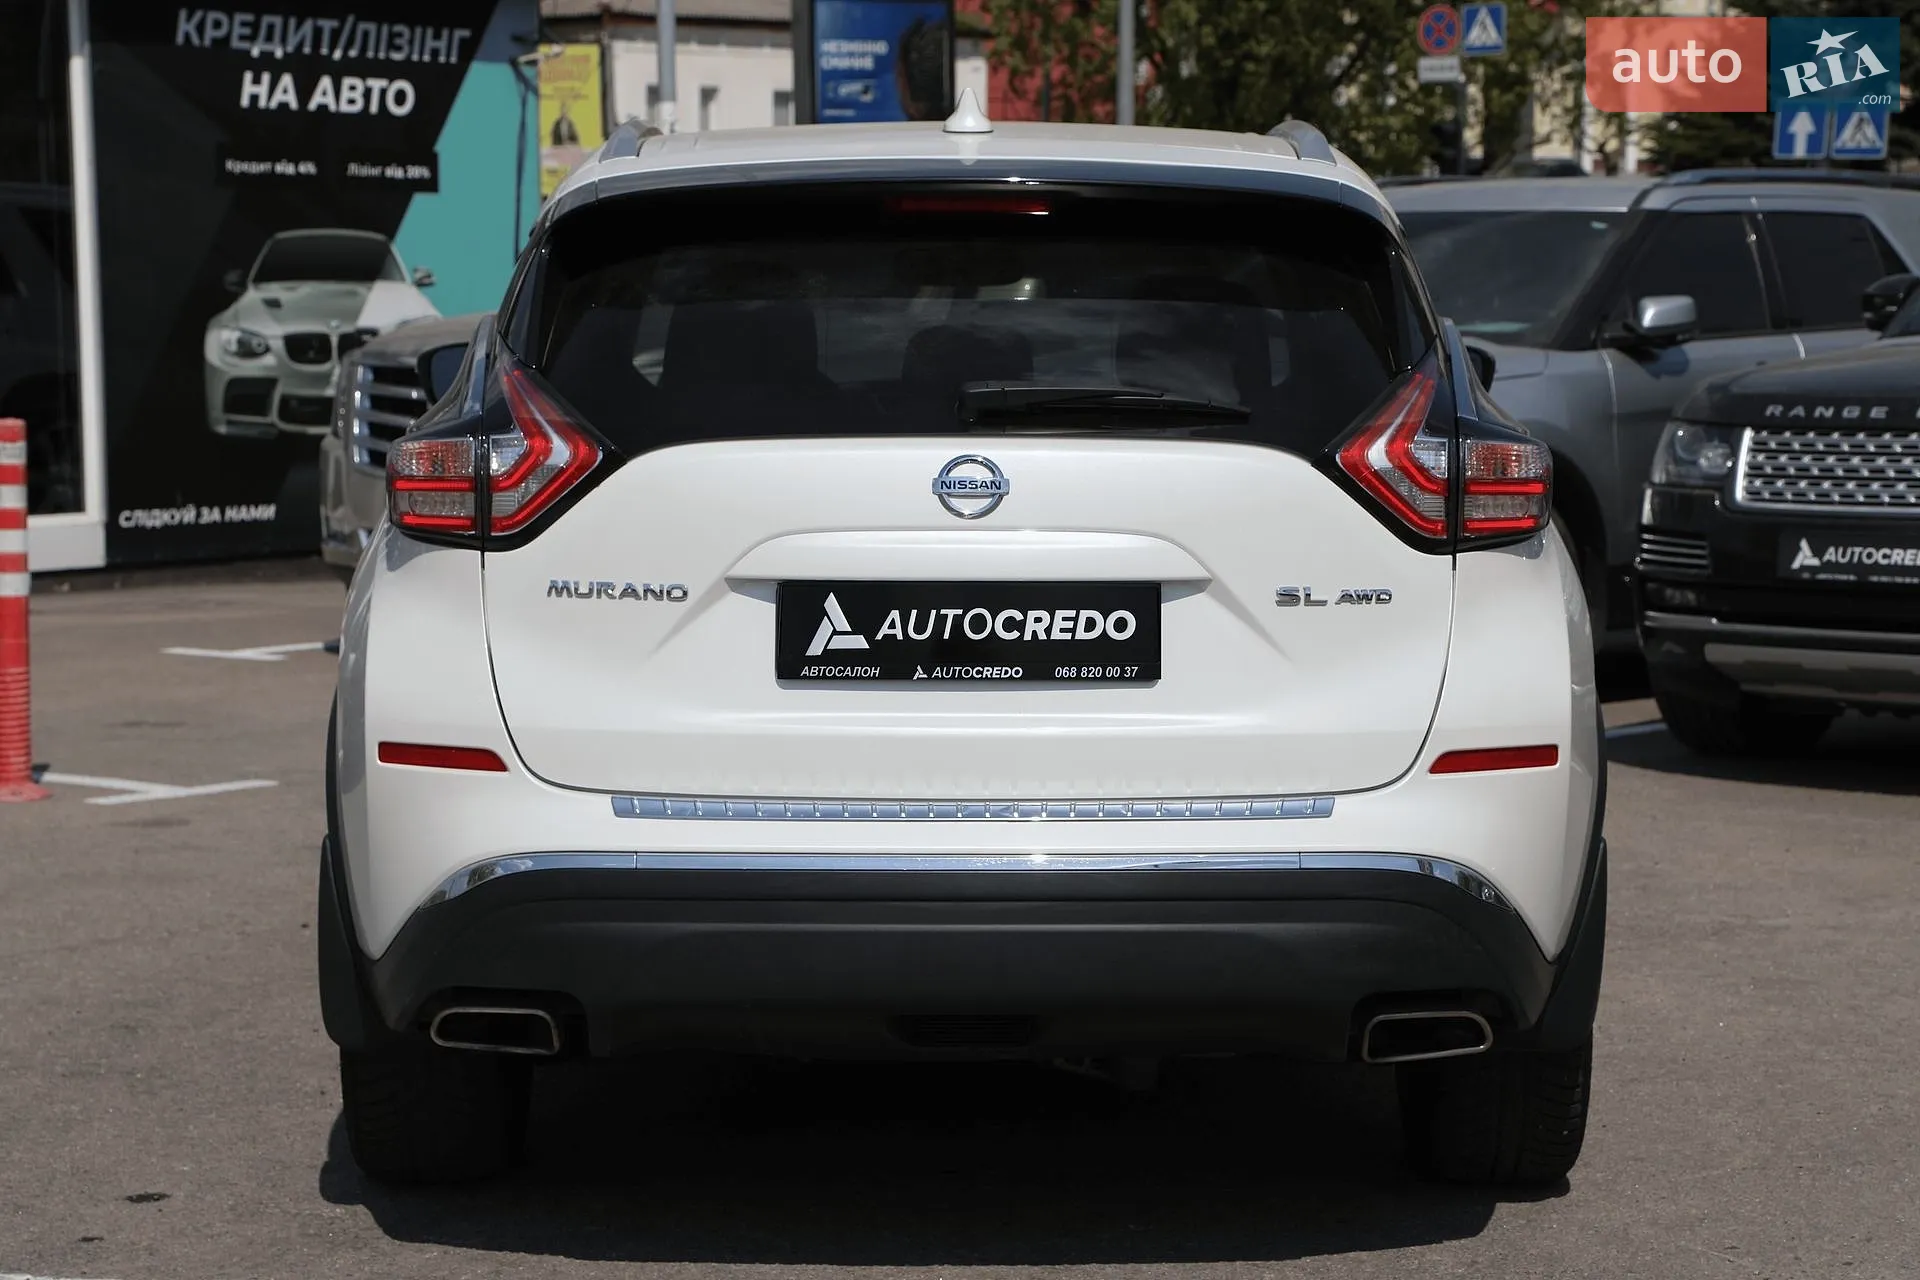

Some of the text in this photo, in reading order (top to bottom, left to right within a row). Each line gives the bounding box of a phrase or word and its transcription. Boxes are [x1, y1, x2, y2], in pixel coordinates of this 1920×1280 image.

[175, 8, 472, 63] КРЕДИТ/ЛІЗІНГ
[240, 70, 416, 117] НА АВТО
[1764, 404, 1889, 419] RANGE
[940, 480, 1002, 490] NISSAN
[118, 503, 277, 529] СЛІДКУЙ ЗА НАМИ
[546, 579, 689, 603] MURANO
[1275, 586, 1393, 607] SL AWD
[874, 608, 1137, 641] AUTOCREDO
[800, 666, 880, 678] АВТОСАЛОН
[932, 667, 1023, 679] AUTOCREDO
[1055, 666, 1138, 678] 068 820 00 37
